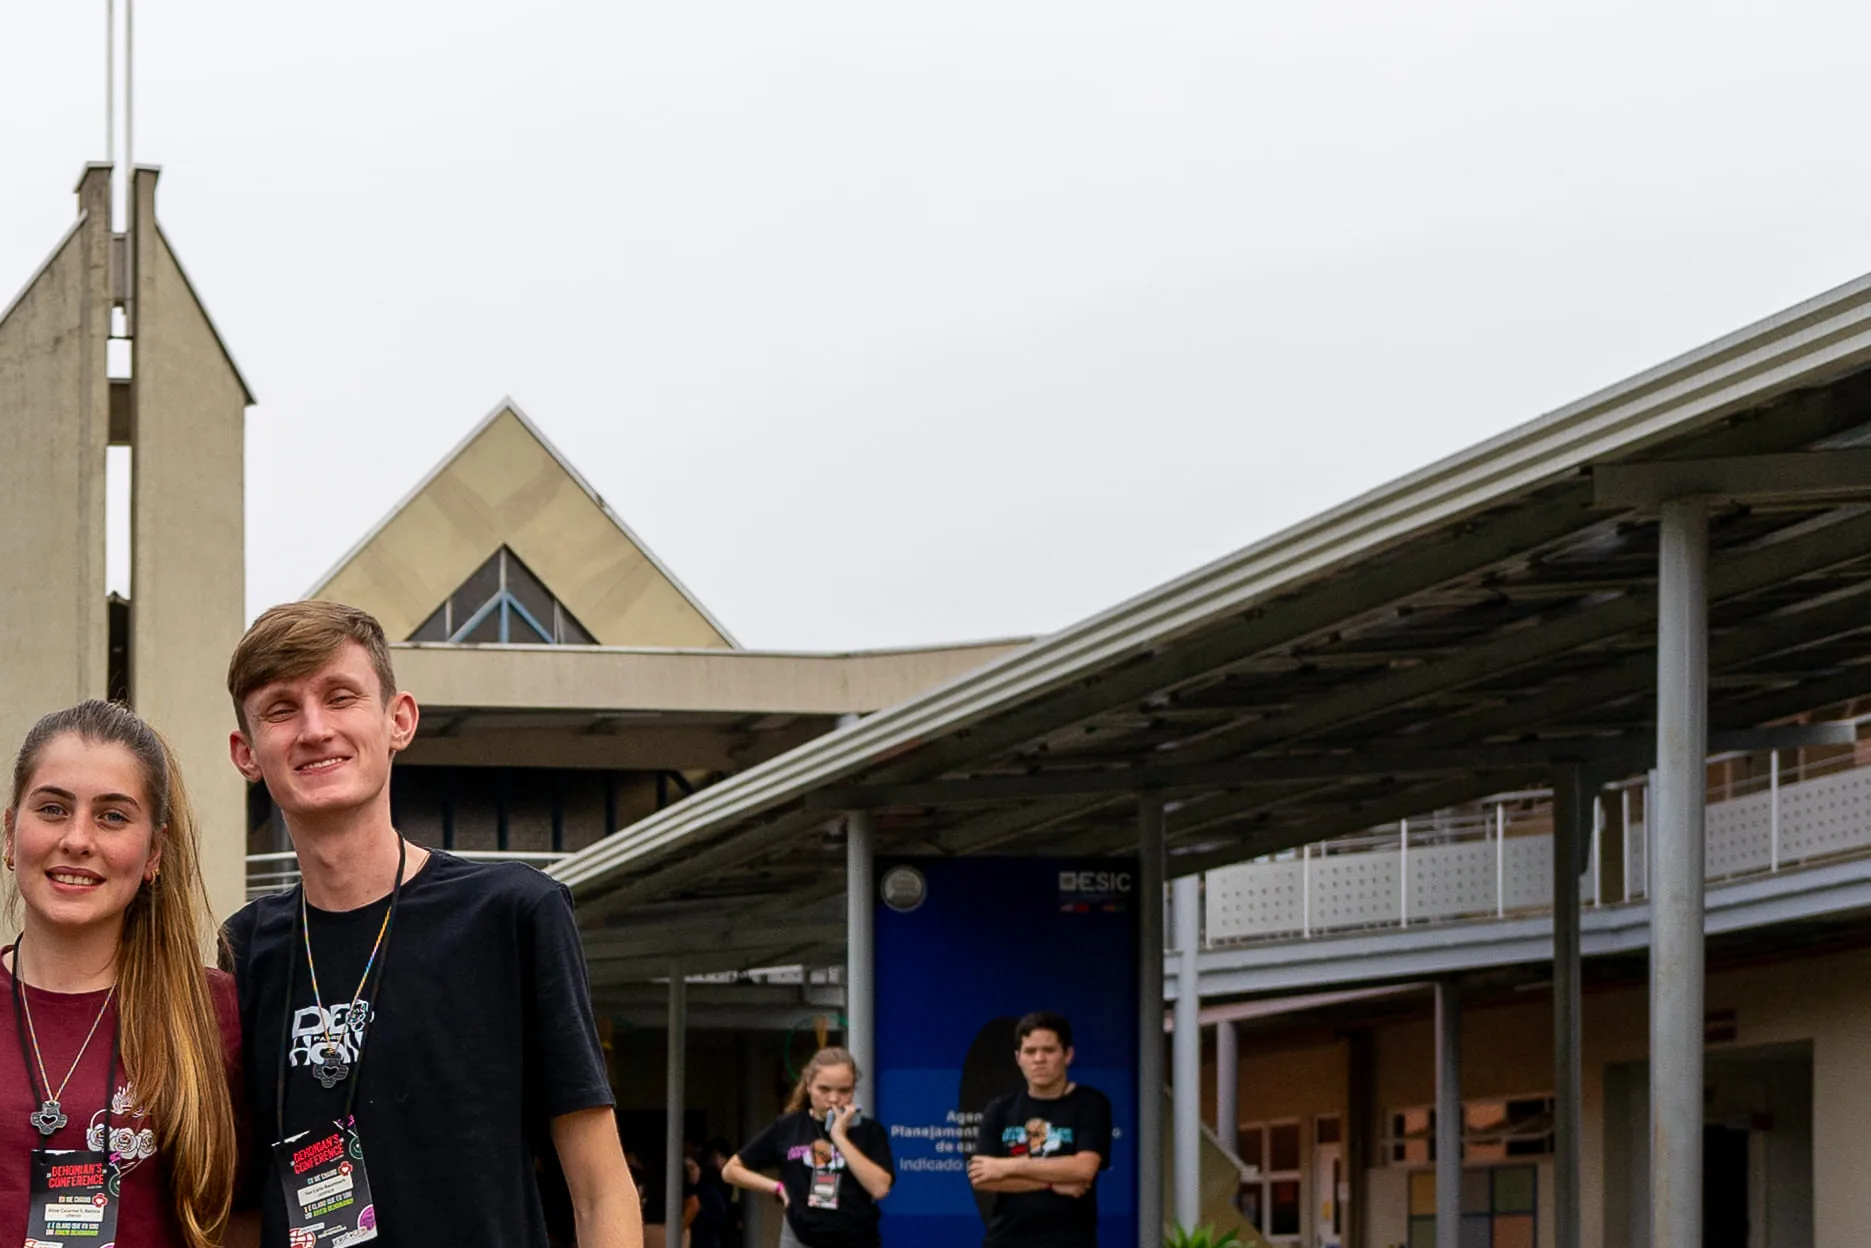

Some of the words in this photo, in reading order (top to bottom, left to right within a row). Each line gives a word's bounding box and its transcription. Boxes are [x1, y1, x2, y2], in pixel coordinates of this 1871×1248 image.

[1077, 872, 1131, 892] ESIC
[946, 1110, 984, 1125] Agen
[891, 1125, 980, 1140] Planejament
[900, 1157, 963, 1171] Indicado
[49, 1174, 104, 1188] CONFERENCE
